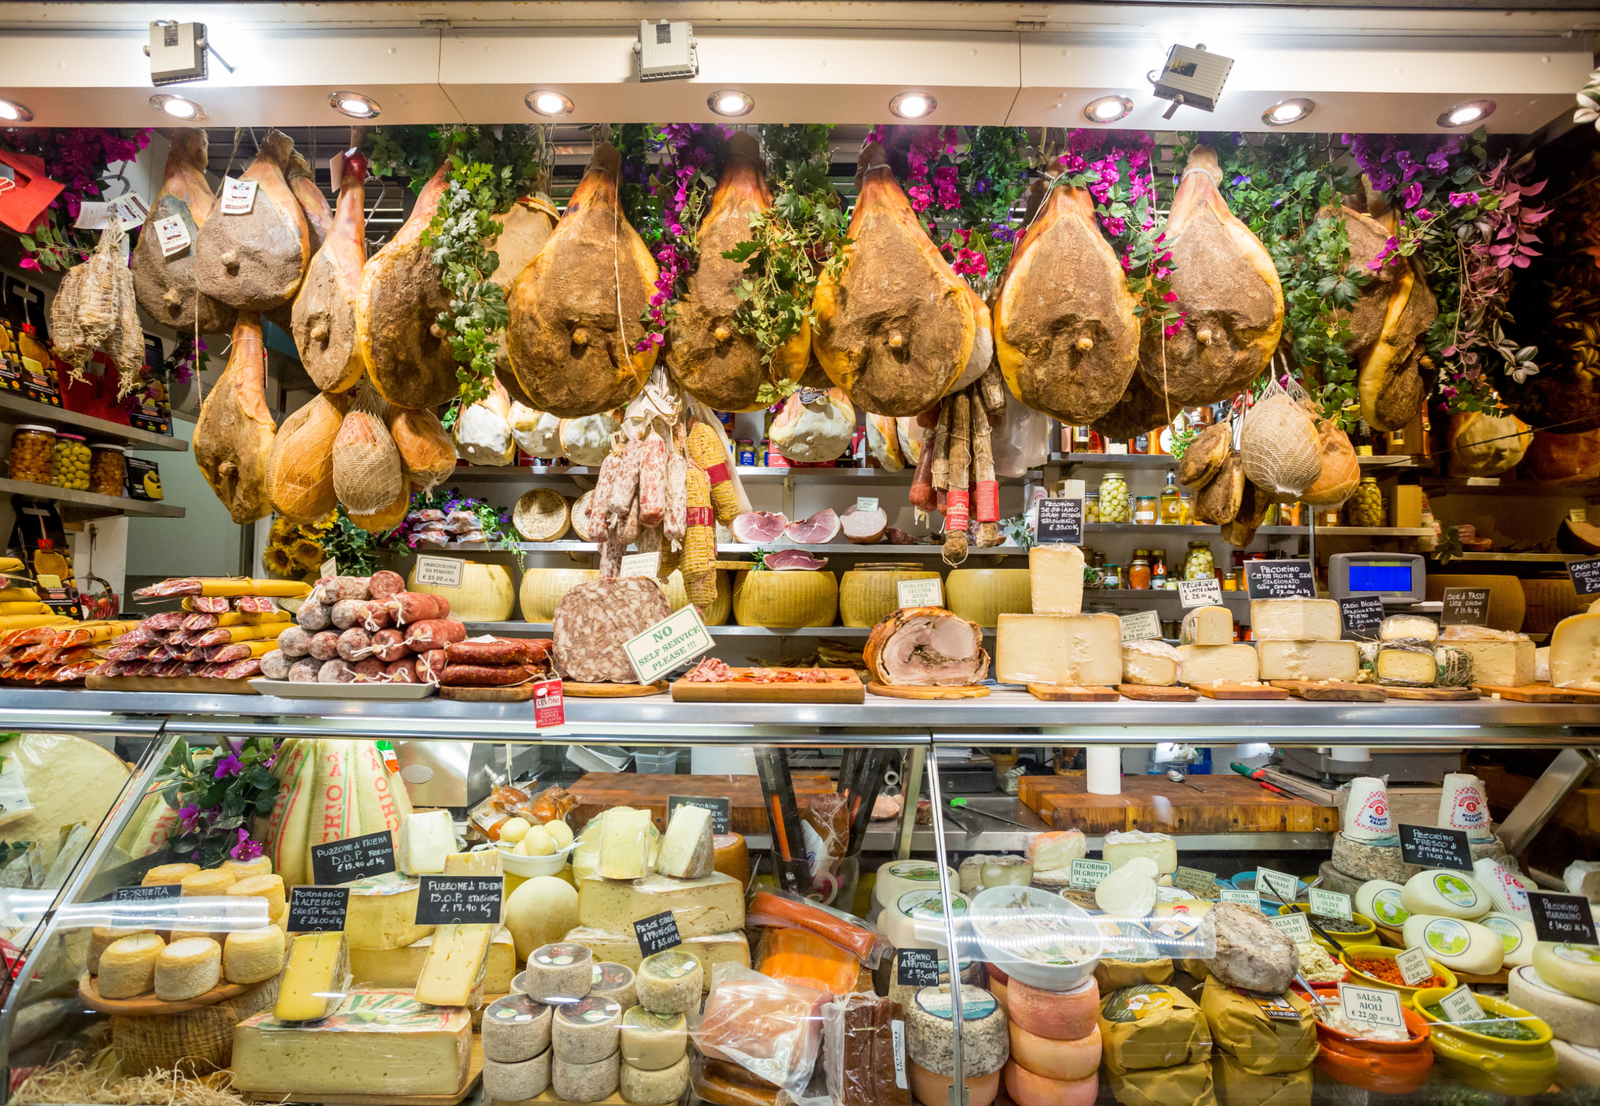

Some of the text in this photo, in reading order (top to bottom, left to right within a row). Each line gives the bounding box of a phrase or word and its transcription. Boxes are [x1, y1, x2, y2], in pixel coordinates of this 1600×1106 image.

[1260, 565, 1300, 573] PECORINO
[1122, 615, 1149, 623] PECORINO
[652, 626, 672, 643] NO
[638, 625, 700, 666] SELF SERVICE
[652, 641, 697, 671] PLEASE !!!
[1413, 829, 1454, 841] PECORINO
[317, 844, 353, 858] PUZZONE
[363, 835, 387, 848] MOENA
[1413, 838, 1448, 848] FRESCO
[332, 848, 392, 865] D.O.P. FRESCO
[337, 864, 343, 873] €
[345, 861, 364, 870] 15.90
[1265, 873, 1290, 883] CROSTINO
[428, 881, 467, 890] PUZZONE
[294, 890, 344, 898] FORMAGGIO
[430, 893, 463, 902] D.O.P.
[1316, 893, 1335, 901] SALSA
[301, 898, 341, 906] ALPEGGIO
[1322, 900, 1339, 908] OLIVE
[1542, 898, 1579, 912] PECORINO
[292, 907, 319, 915] CROSTA
[480, 903, 491, 918] Kg
[300, 916, 306, 924] €
[1549, 921, 1553, 929] €
[636, 920, 658, 934] PESCE
[903, 951, 930, 961] TONNO
[1405, 954, 1417, 963] SALSA
[901, 959, 938, 969] AFFUMICATO
[1405, 960, 1424, 973] PICCANTE
[908, 969, 913, 978] €
[1357, 993, 1382, 1002] SALSA
[1452, 996, 1466, 1007] SALSA
[1457, 1003, 1472, 1015] VERDE
